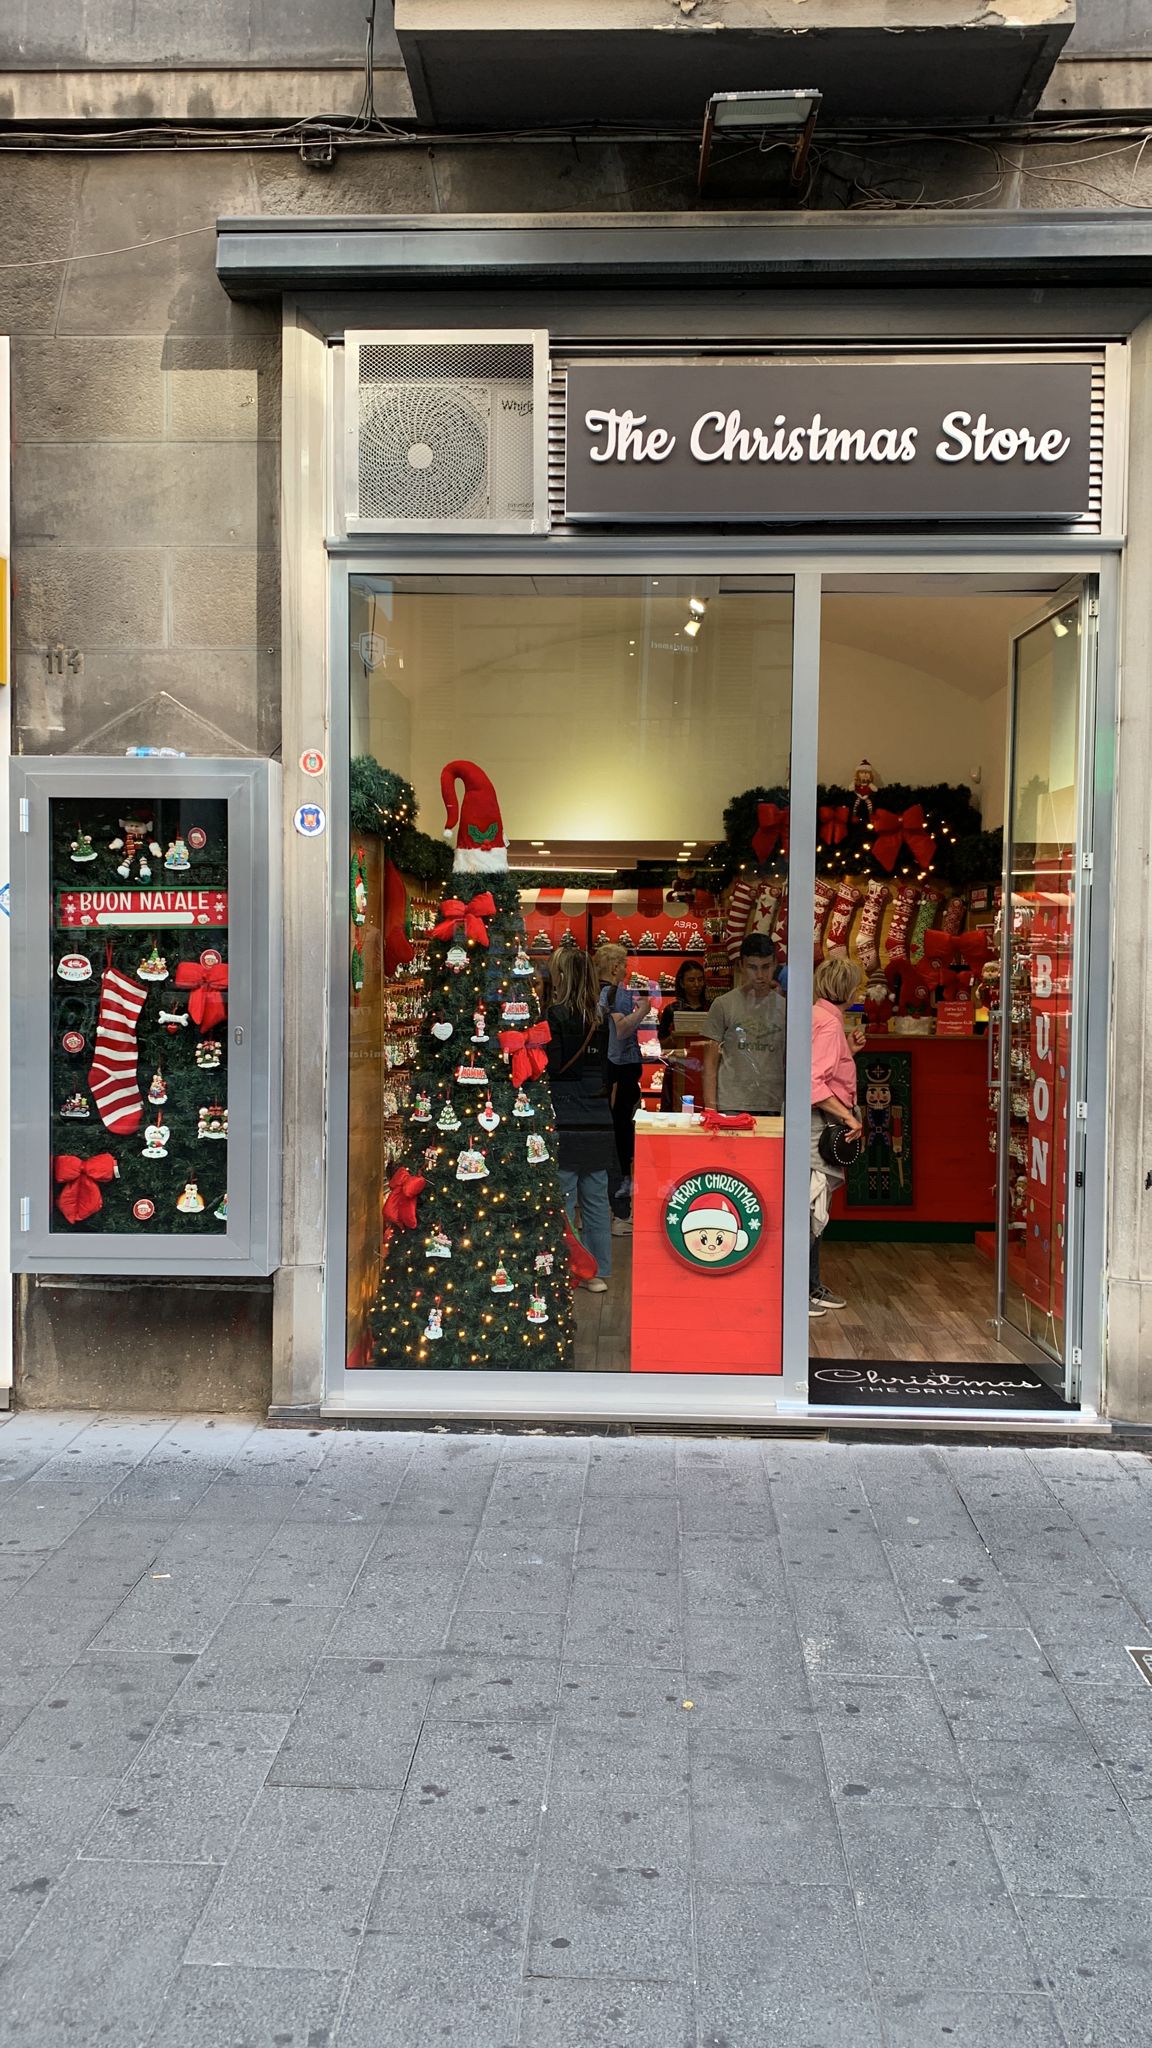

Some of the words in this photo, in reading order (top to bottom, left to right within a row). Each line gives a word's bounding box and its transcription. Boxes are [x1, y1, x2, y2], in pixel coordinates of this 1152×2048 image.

[586, 409, 675, 462] The
[690, 409, 917, 463] Christmas
[935, 410, 1071, 464] Store
[45, 649, 81, 674] 114
[80, 892, 132, 911] BUON
[140, 891, 210, 911] NATALE
[1031, 954, 1053, 1186] BUON
[668, 1176, 702, 1211] MERRY
[705, 1173, 760, 1214] CHRISTMAS
[814, 1368, 1042, 1389] Christmas
[905, 1387, 1016, 1397] ORIGINAL
